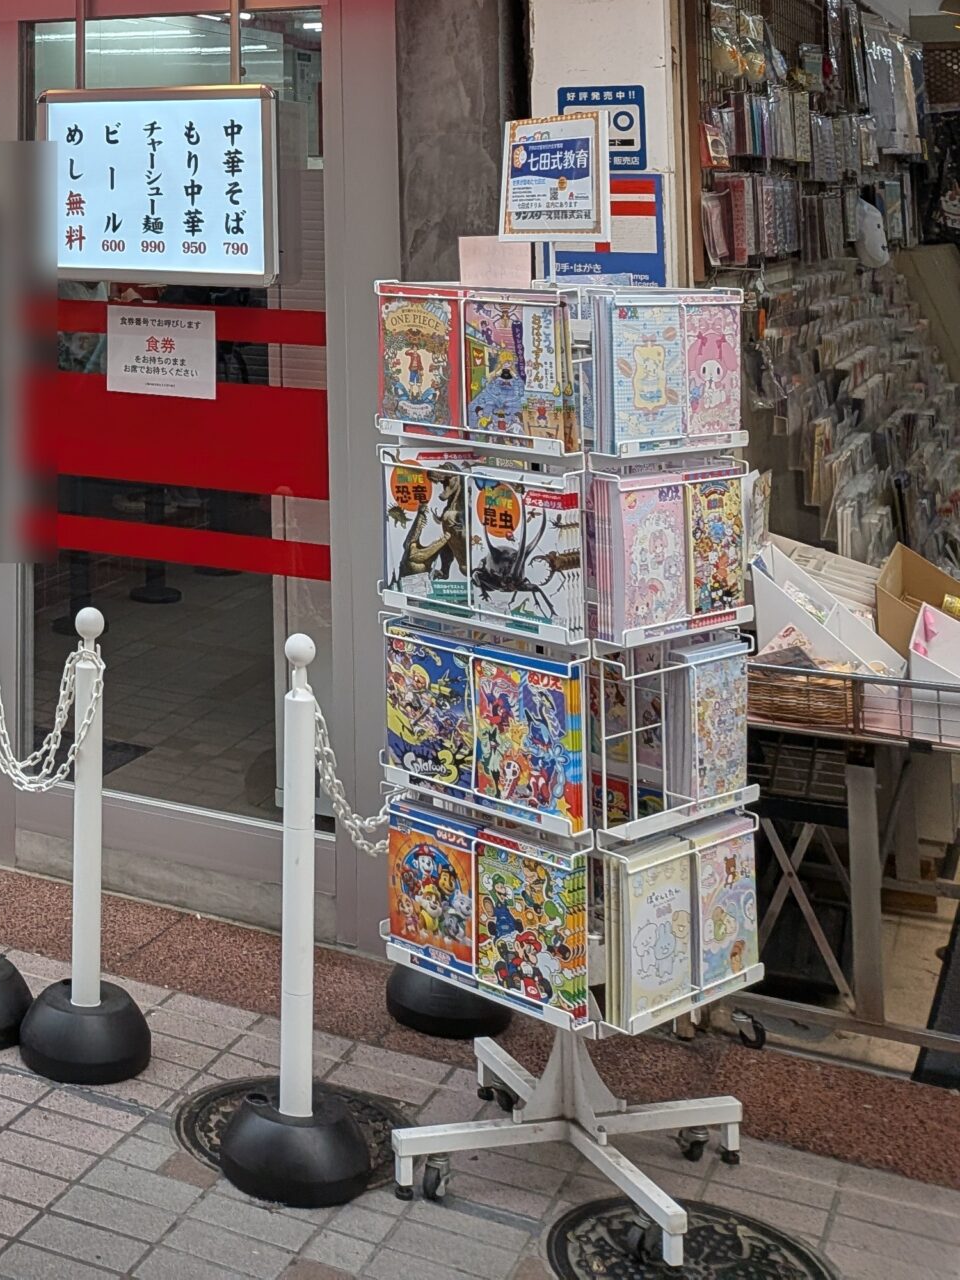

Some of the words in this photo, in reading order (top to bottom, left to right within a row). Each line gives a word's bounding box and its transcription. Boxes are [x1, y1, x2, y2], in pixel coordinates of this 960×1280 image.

[527, 149, 589, 172] 七田式教育
[104, 122, 123, 234] ビール
[142, 121, 164, 235] チャーシュー麺
[183, 121, 205, 237] もり中華
[223, 119, 247, 235] 中華そば
[65, 124, 86, 252] めし無料
[101, 240, 126, 253] 600
[141, 240, 165, 253] 990
[182, 241, 207, 254] 950
[223, 242, 249, 255] 790
[120, 317, 201, 329] 食券番号でお呼びします
[391, 314, 410, 326] ONE
[413, 314, 441, 330] PIECE
[145, 336, 175, 354] 食券
[134, 355, 186, 366] をお持ちのまま
[123, 364, 198, 377] お席でお待ちください
[395, 485, 428, 503] 恐竜
[483, 507, 513, 528] 昆虫
[528, 672, 563, 690] ぬりえ
[403, 751, 447, 774] Splatoon
[433, 750, 458, 785] 3
